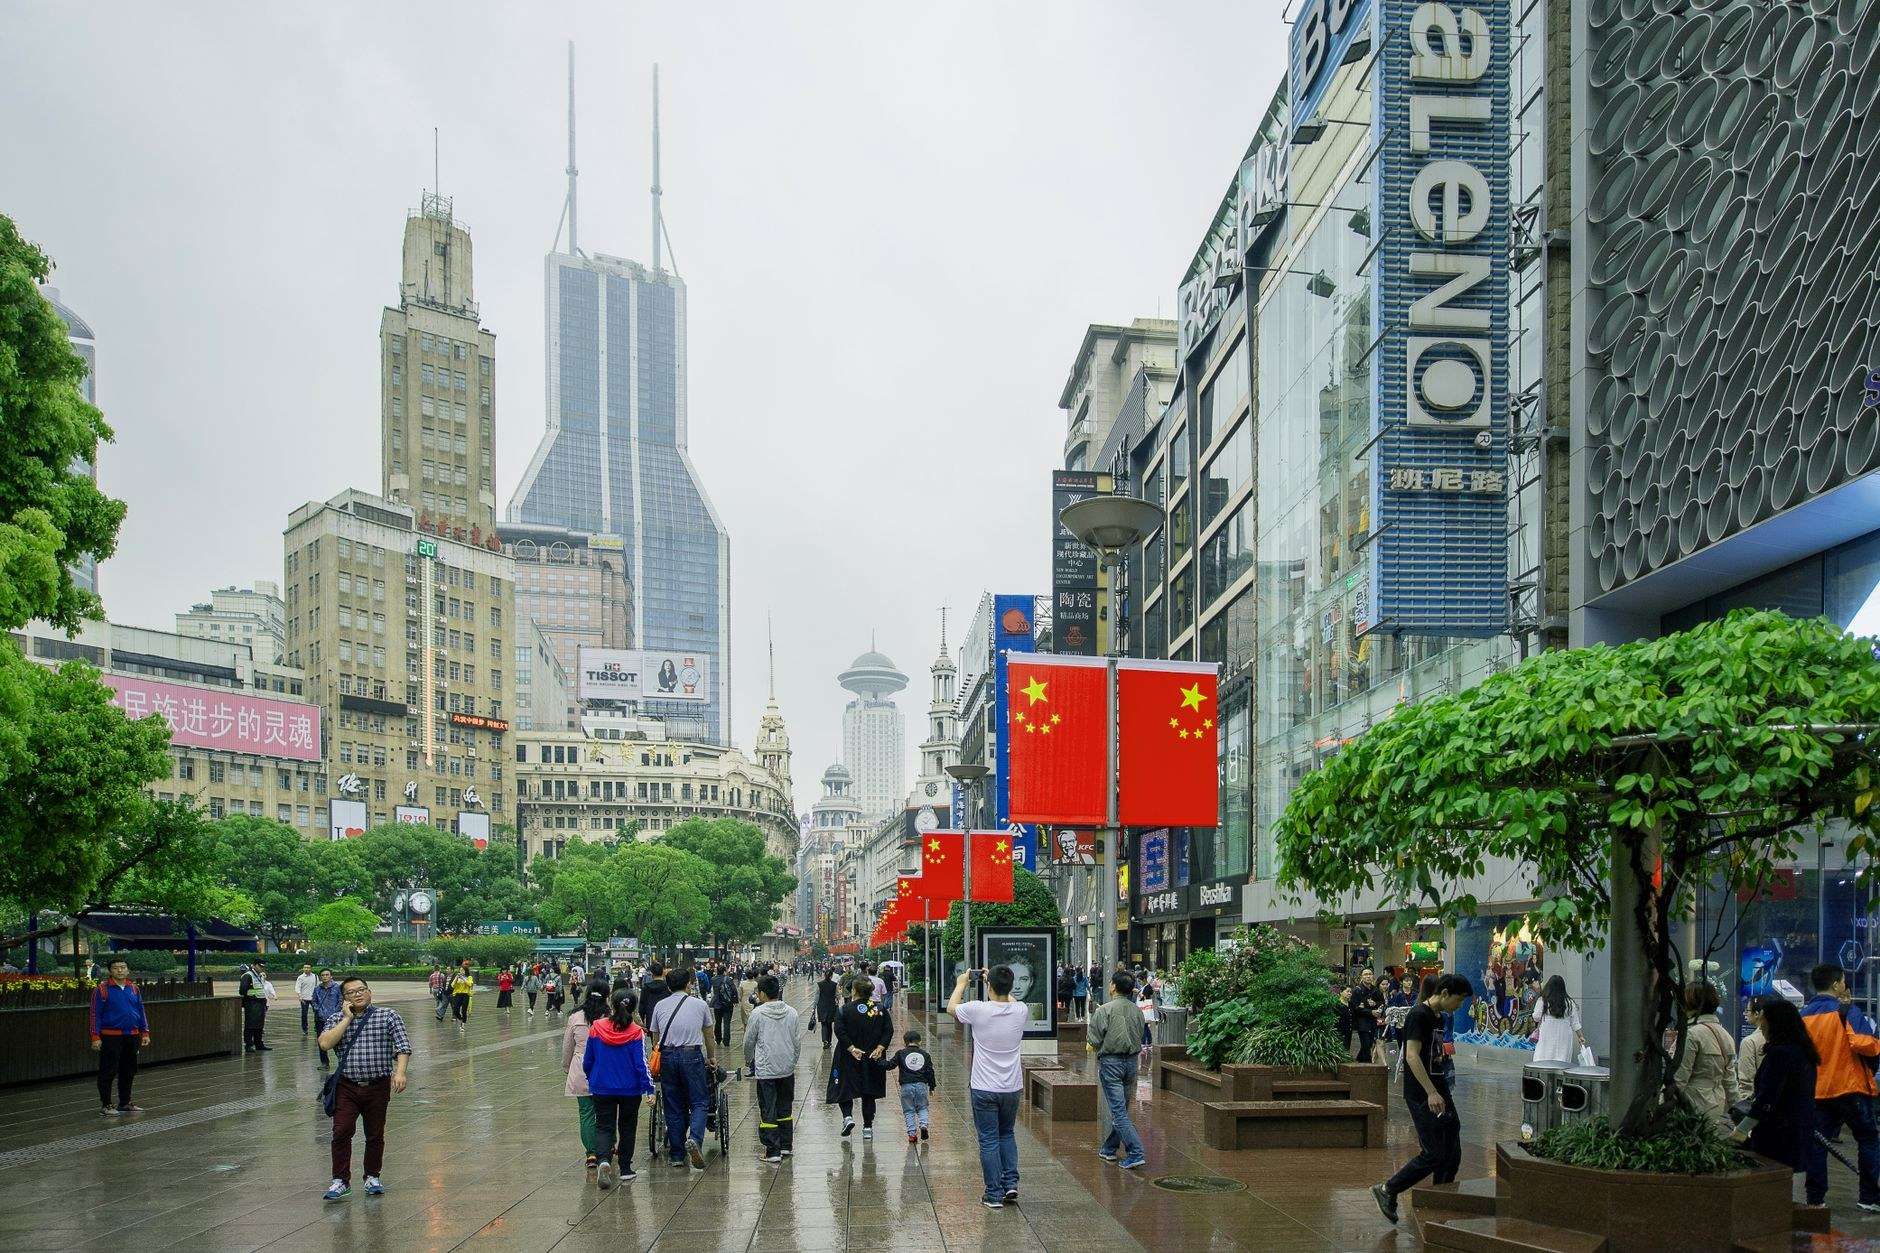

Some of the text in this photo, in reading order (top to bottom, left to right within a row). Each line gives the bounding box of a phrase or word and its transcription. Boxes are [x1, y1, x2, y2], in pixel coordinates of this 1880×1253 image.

[1391, 467, 1503, 491] 班尼路
[1067, 559, 1084, 567] 中心
[1060, 592, 1092, 608] 陶瓷
[586, 670, 638, 682] TISSOT
[113, 690, 313, 750] 民族进步的灵魂
